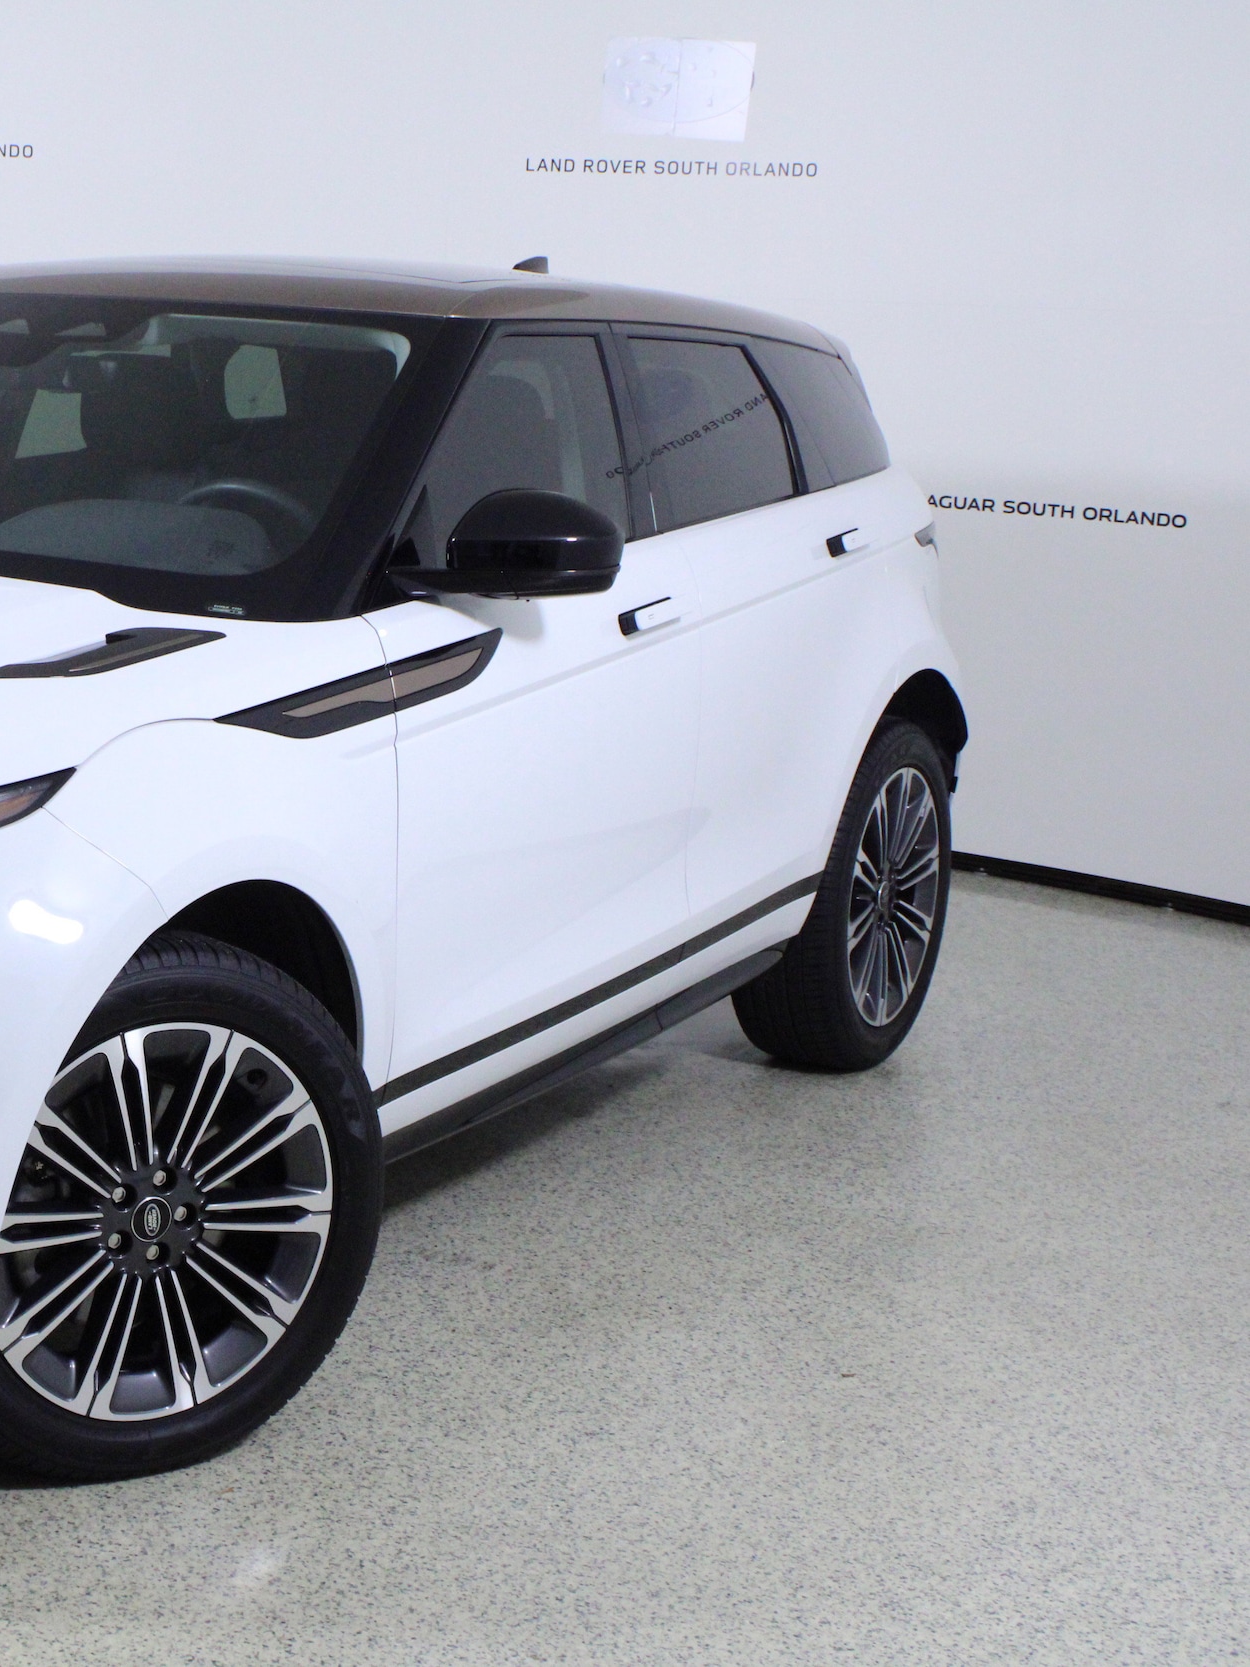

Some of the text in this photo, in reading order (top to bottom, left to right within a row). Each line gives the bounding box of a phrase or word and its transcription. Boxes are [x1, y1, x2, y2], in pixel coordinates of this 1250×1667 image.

[525, 157, 818, 178] LAND ROVER SOUTH ORLANDO
[927, 494, 1188, 529] AGUAR SOUTH ORLANDO
